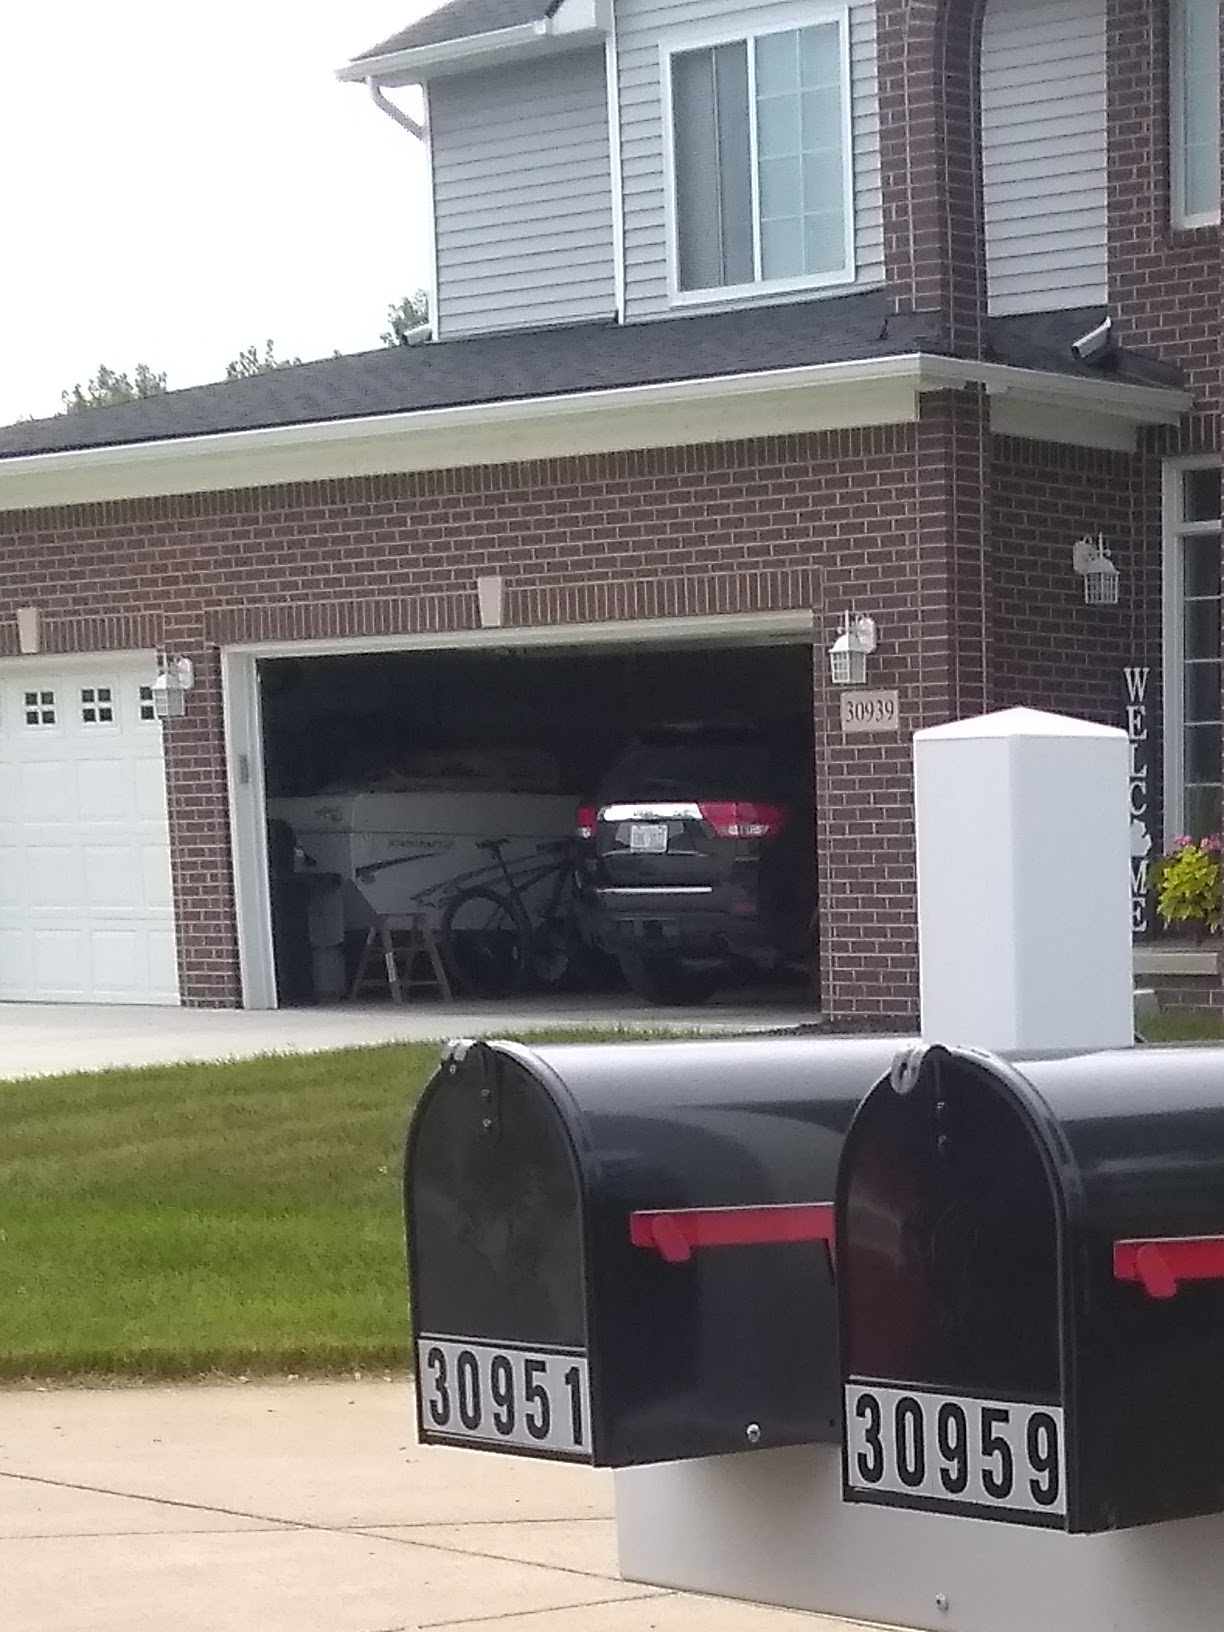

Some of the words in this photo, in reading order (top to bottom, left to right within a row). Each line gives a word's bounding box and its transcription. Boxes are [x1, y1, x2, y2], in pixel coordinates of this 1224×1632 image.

[846, 699, 894, 722] 30939
[427, 1346, 584, 1446] 30951
[855, 1392, 1061, 1506] 30959
